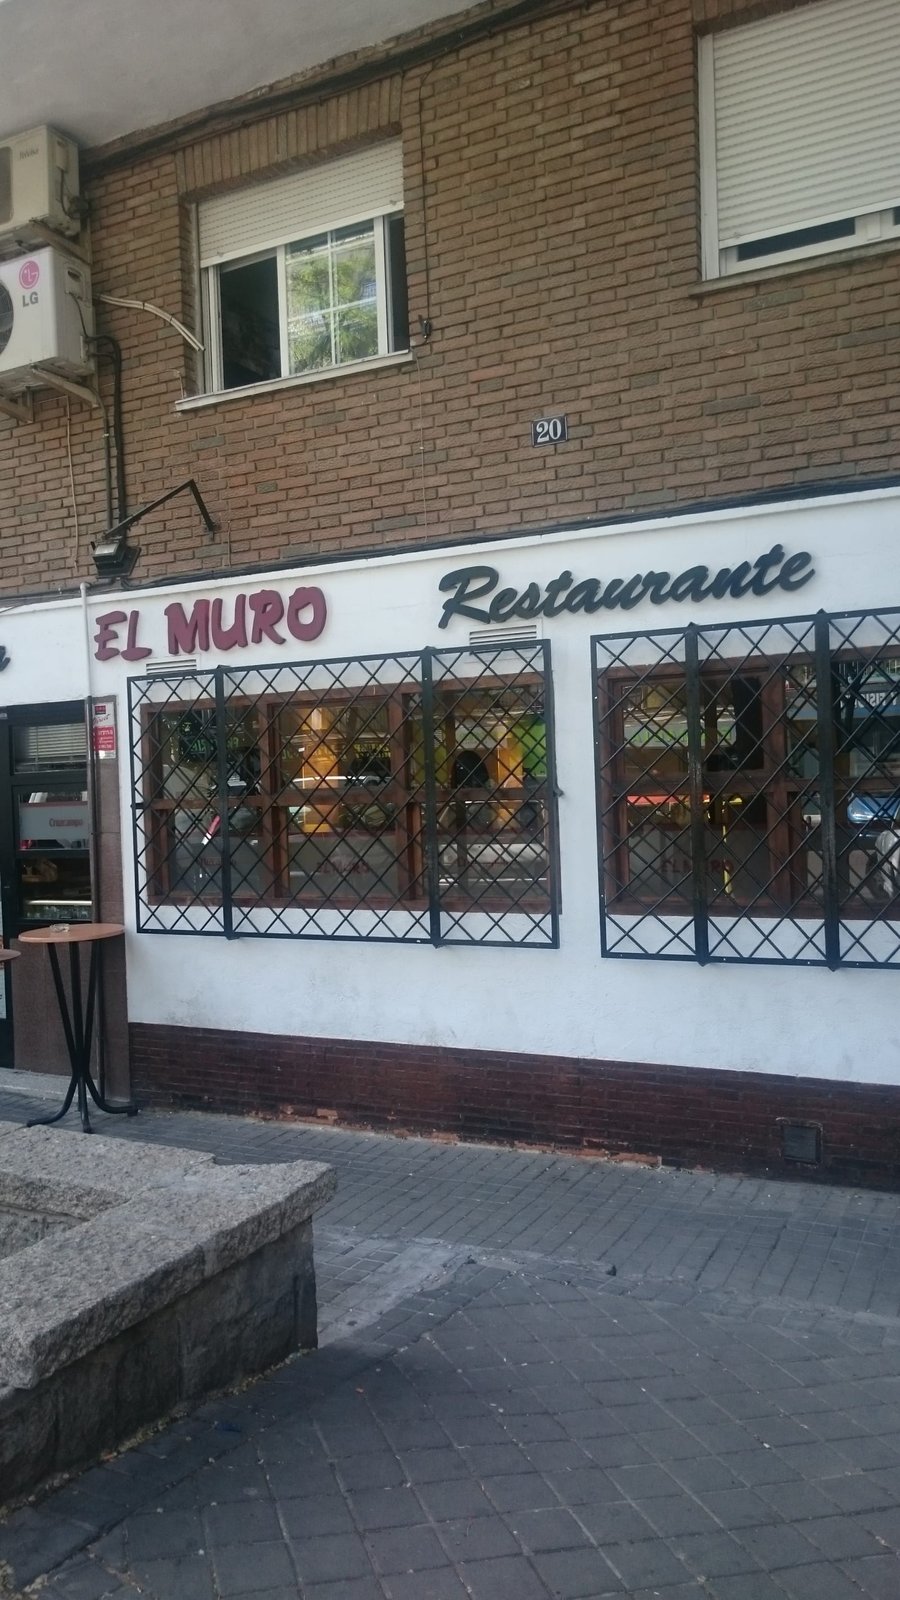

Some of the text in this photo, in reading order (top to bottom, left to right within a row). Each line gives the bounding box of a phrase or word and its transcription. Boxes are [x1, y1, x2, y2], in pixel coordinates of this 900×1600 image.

[22, 291, 39, 308] LG
[536, 418, 562, 443] 20
[438, 543, 816, 629] Restaurante
[94, 586, 327, 661] EL MURO
